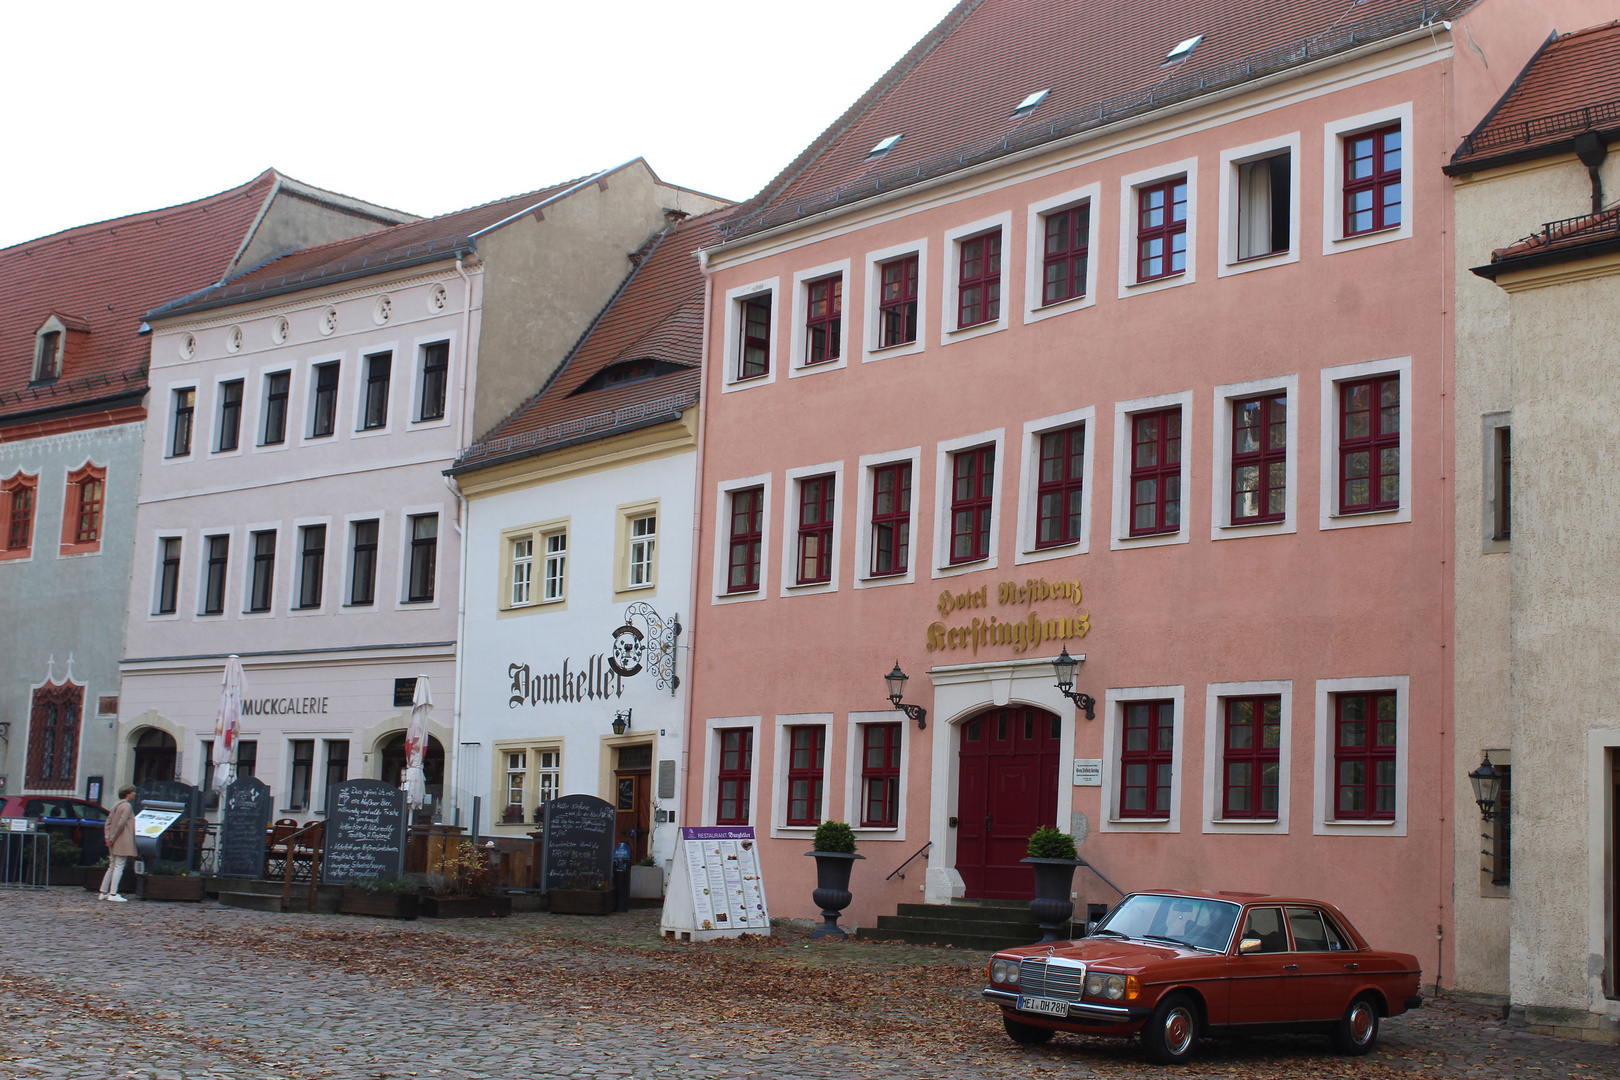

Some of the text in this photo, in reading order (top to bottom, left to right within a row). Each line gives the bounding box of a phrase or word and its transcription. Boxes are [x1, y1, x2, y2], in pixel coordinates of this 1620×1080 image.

[937, 584, 987, 618] Hotel
[508, 653, 625, 709] Domkeller
[240, 697, 329, 715] MUCKGALERIE
[1022, 998, 1035, 1009] MEI
[1040, 1001, 1050, 1011] DH
